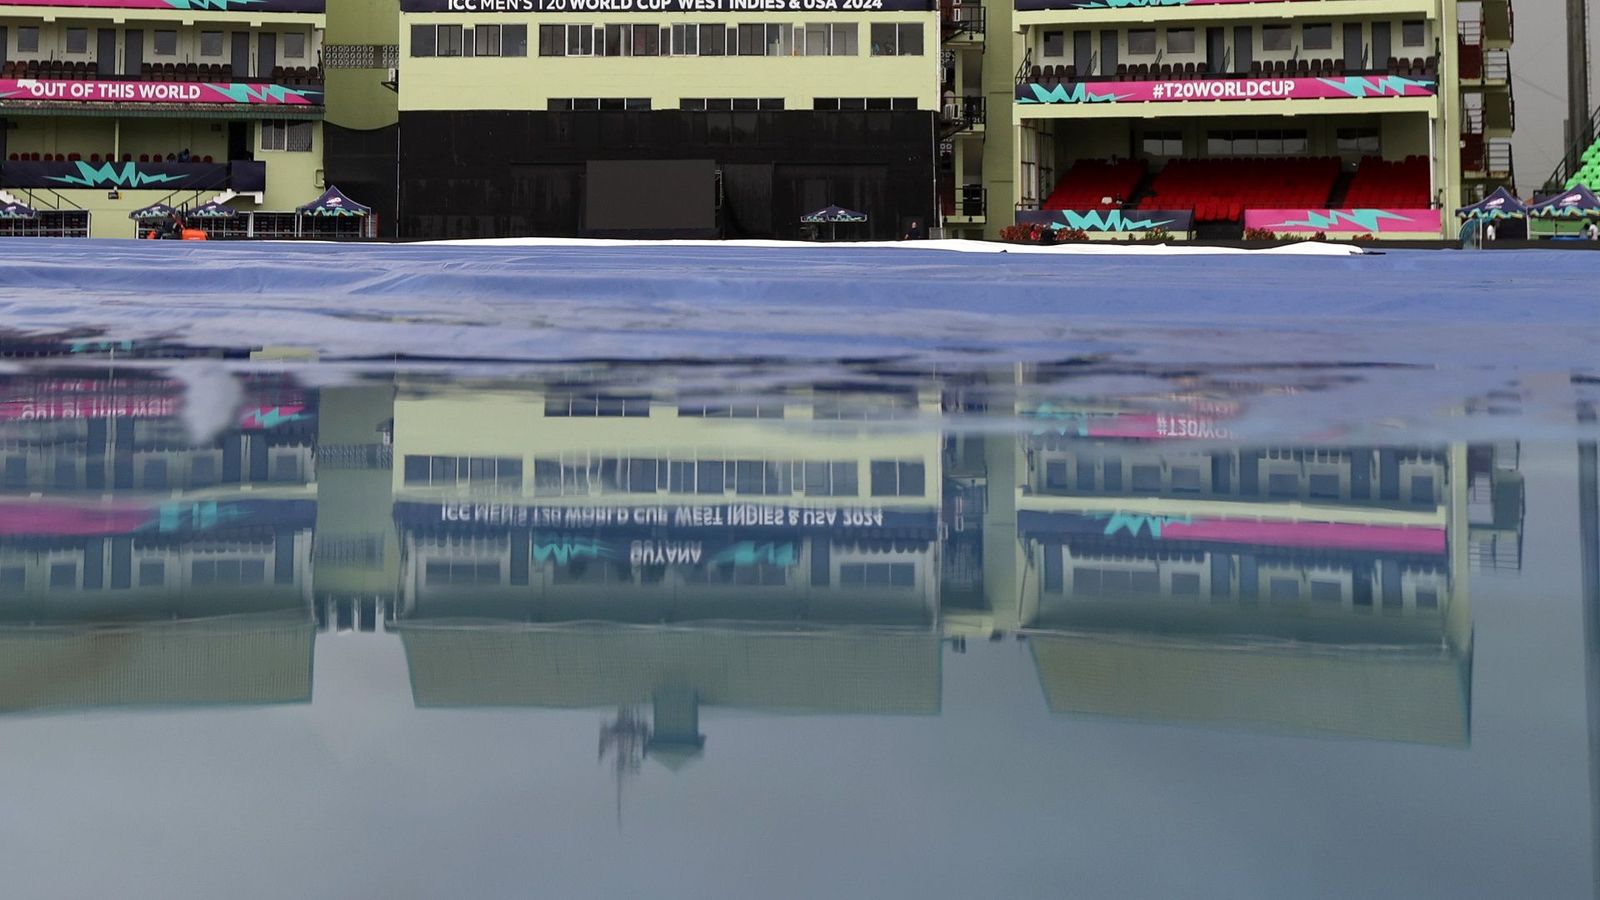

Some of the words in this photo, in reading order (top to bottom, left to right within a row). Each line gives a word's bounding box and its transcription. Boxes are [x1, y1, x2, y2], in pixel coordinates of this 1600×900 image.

[448, 0, 477, 10] ICC
[481, 0, 533, 10] MEN'S
[570, 0, 633, 10] WORLD
[636, 0, 672, 10] CUP
[679, 0, 723, 10] WEST
[729, 0, 785, 10] INDIES
[789, 0, 801, 10] &
[803, 0, 838, 10] USA
[842, 0, 883, 10] 2024
[31, 83, 67, 97] OUT
[70, 83, 95, 98] OF
[98, 83, 135, 98] THIS
[139, 84, 201, 99] WORLD
[1152, 80, 1295, 98] #T20WORLDCUP
